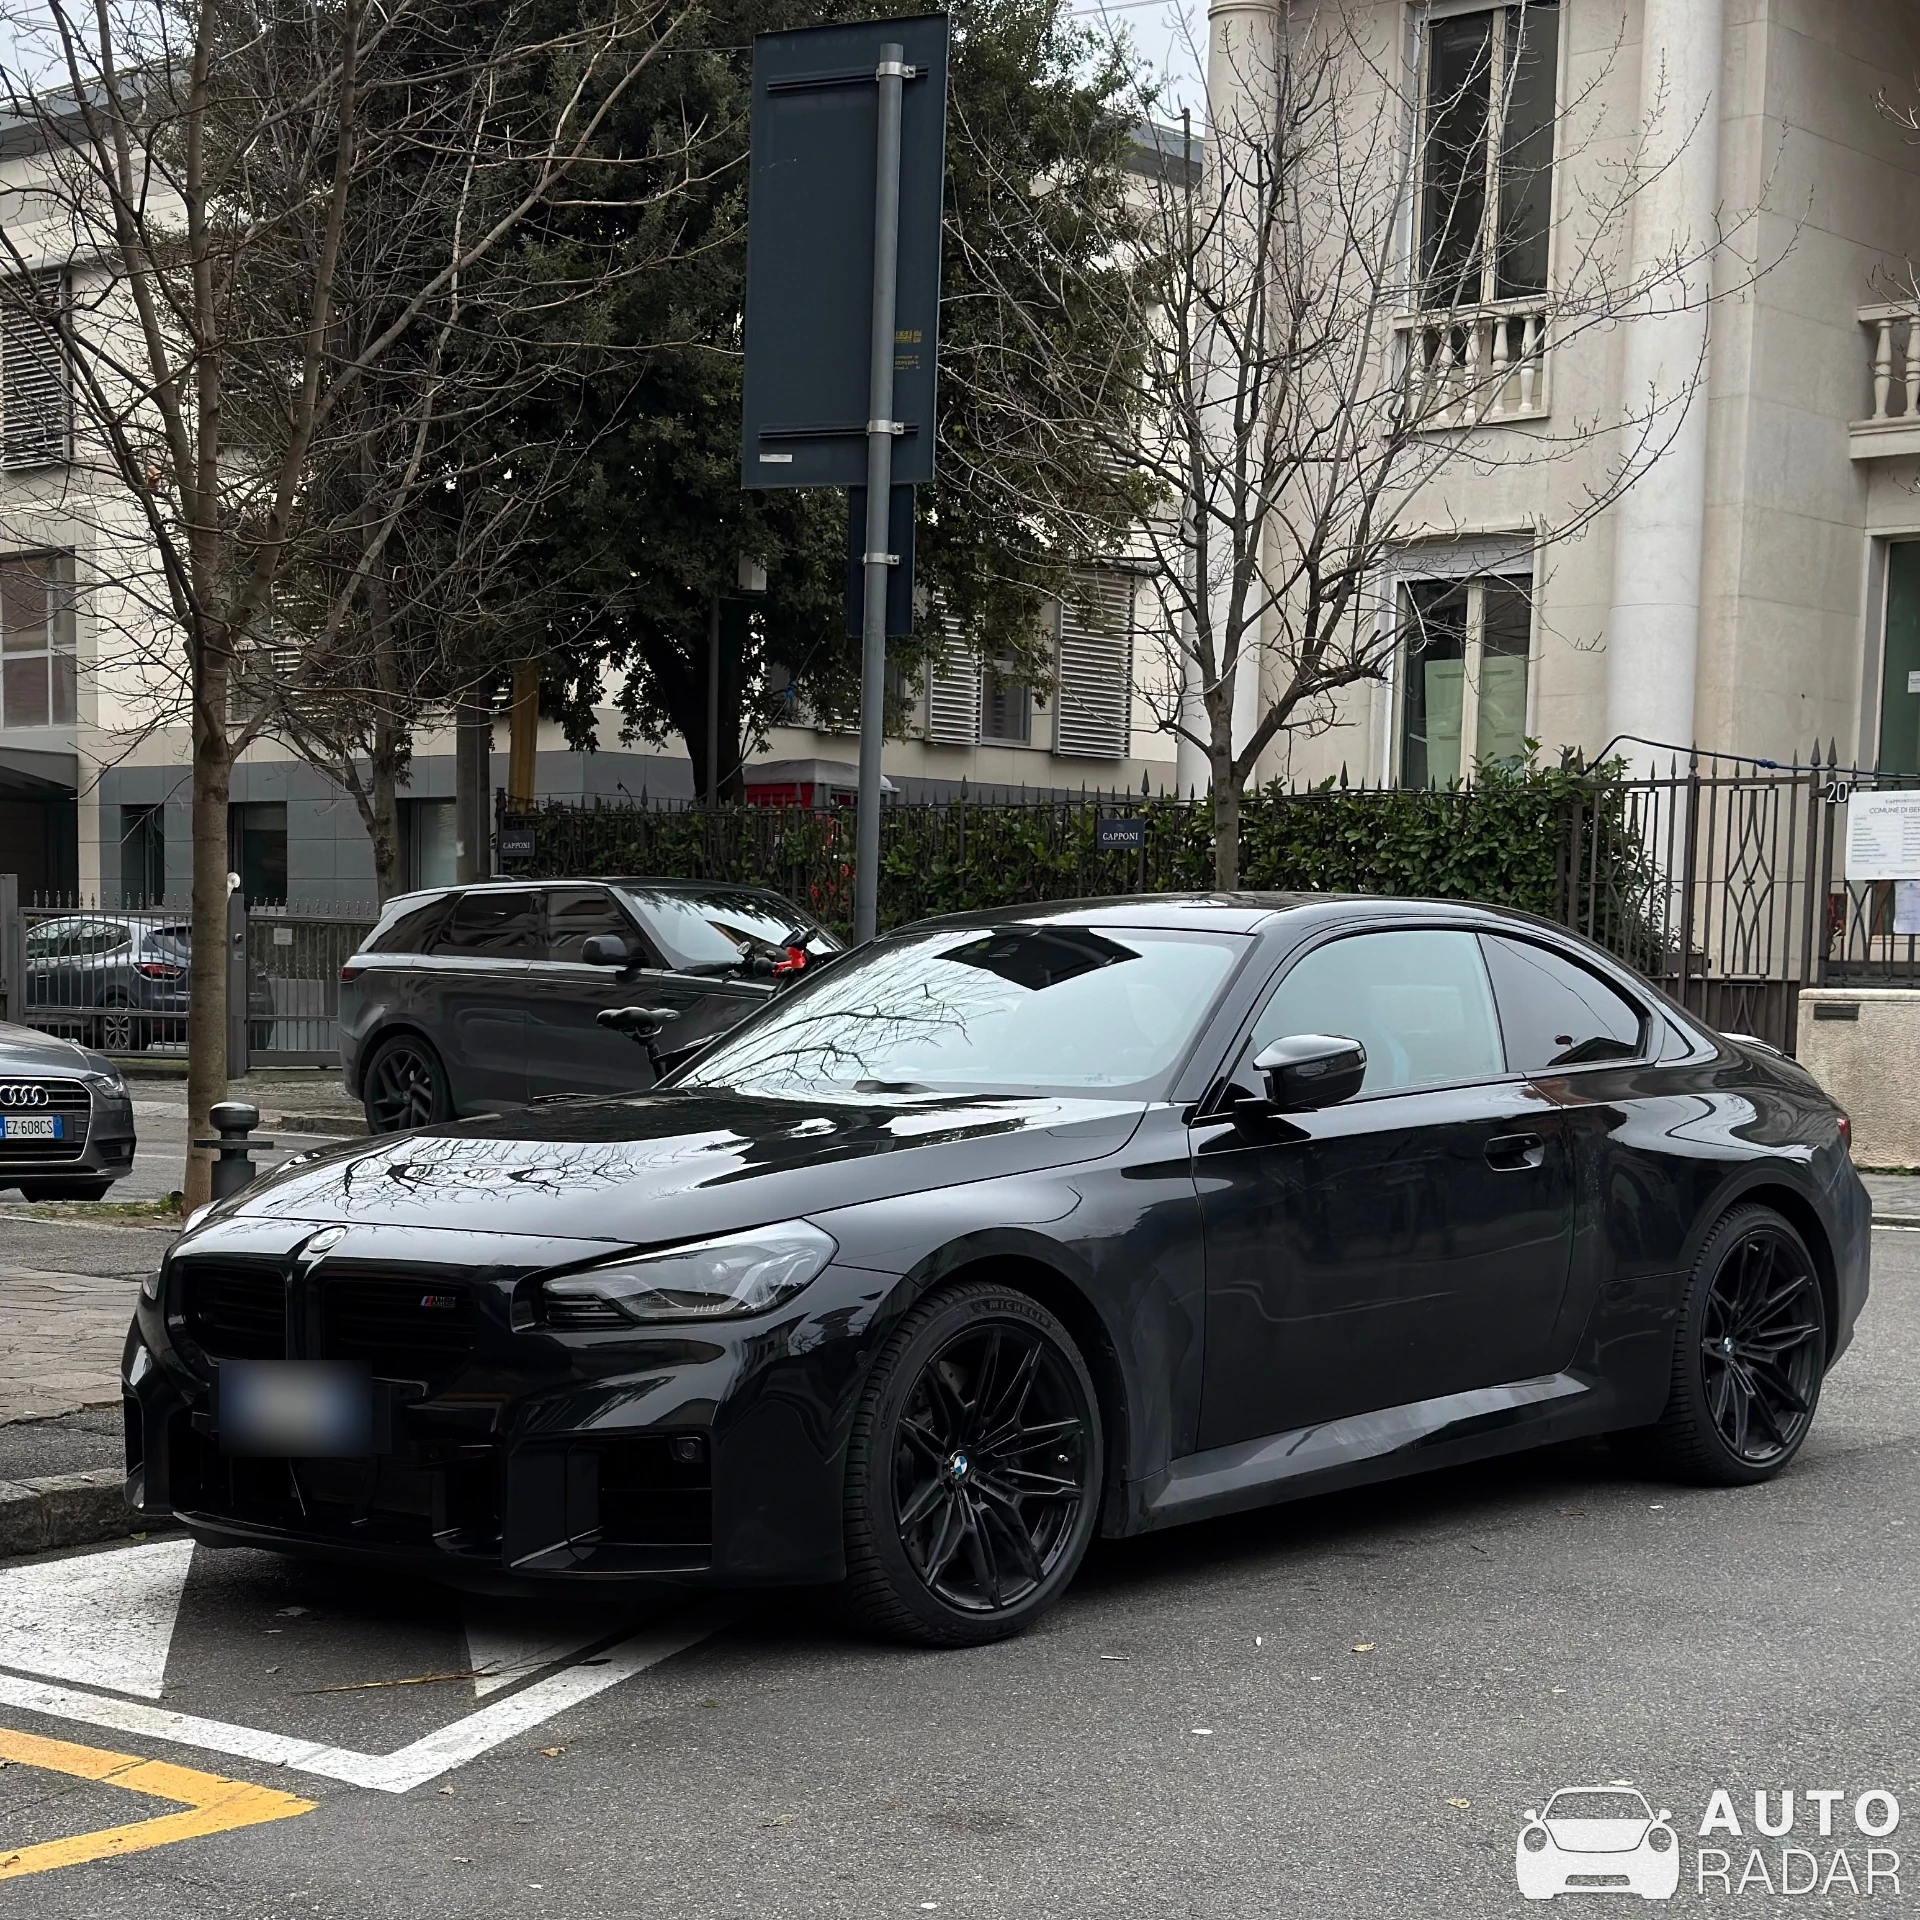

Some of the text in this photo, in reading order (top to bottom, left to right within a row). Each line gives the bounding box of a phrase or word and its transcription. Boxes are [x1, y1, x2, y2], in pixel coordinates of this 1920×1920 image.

[1826, 781, 1848, 803] 20
[1869, 806, 1899, 814] COMUNE
[1102, 832, 1138, 841] CAPPONI
[5, 1120, 18, 1135] EZ
[21, 1120, 53, 1135] 608CS
[988, 1299, 1049, 1326] MICHELIN
